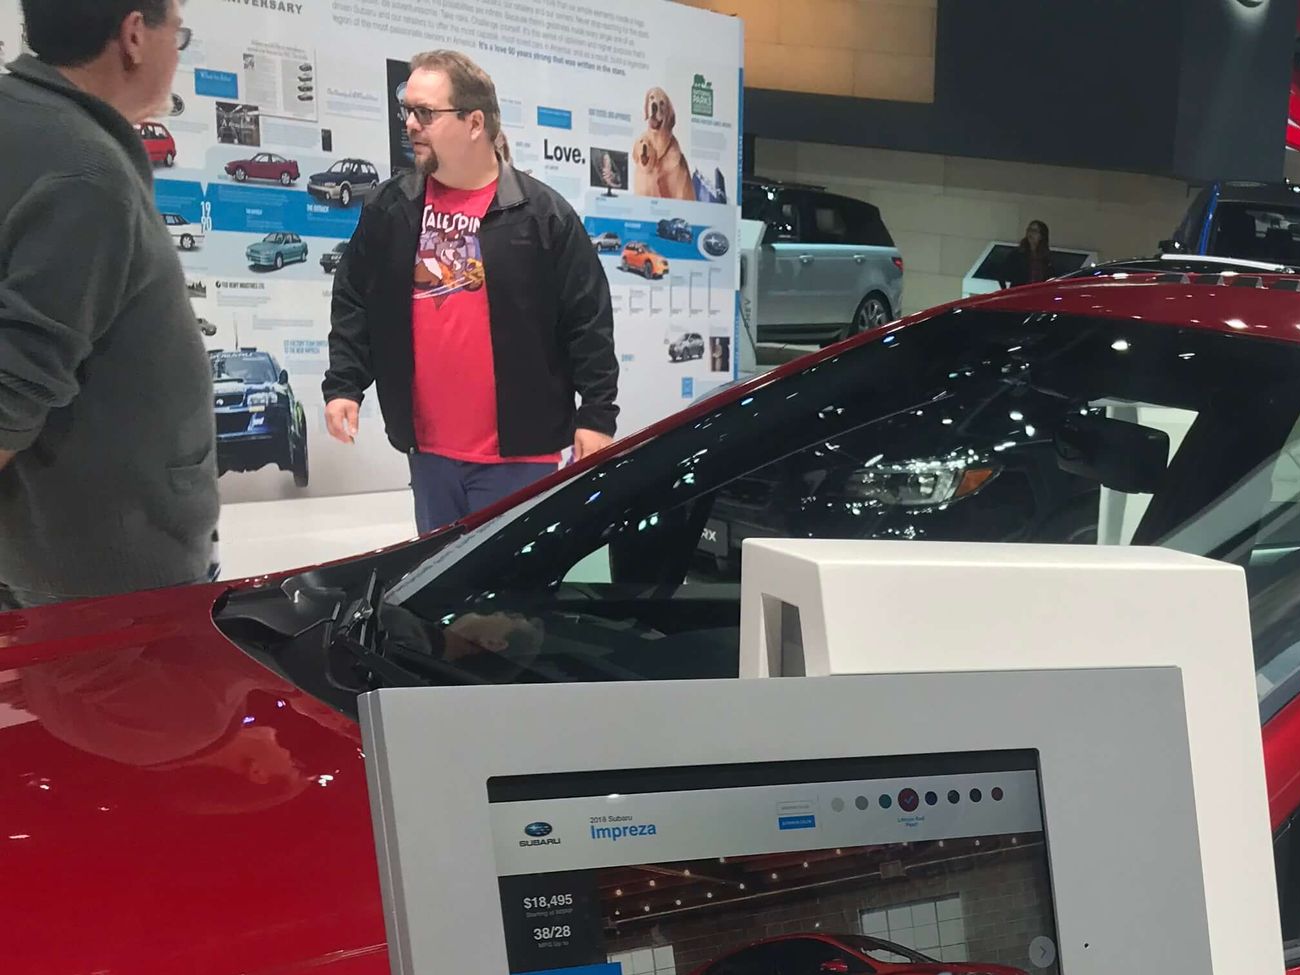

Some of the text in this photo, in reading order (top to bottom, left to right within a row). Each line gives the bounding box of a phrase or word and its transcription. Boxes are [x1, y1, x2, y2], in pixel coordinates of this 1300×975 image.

[227, 0, 302, 14] VERSARY
[544, 138, 586, 165] Love.
[590, 823, 657, 841] Impreza
[519, 838, 561, 847] SUBARU
[523, 893, 573, 909] $18,495
[533, 925, 571, 940] 38/28
